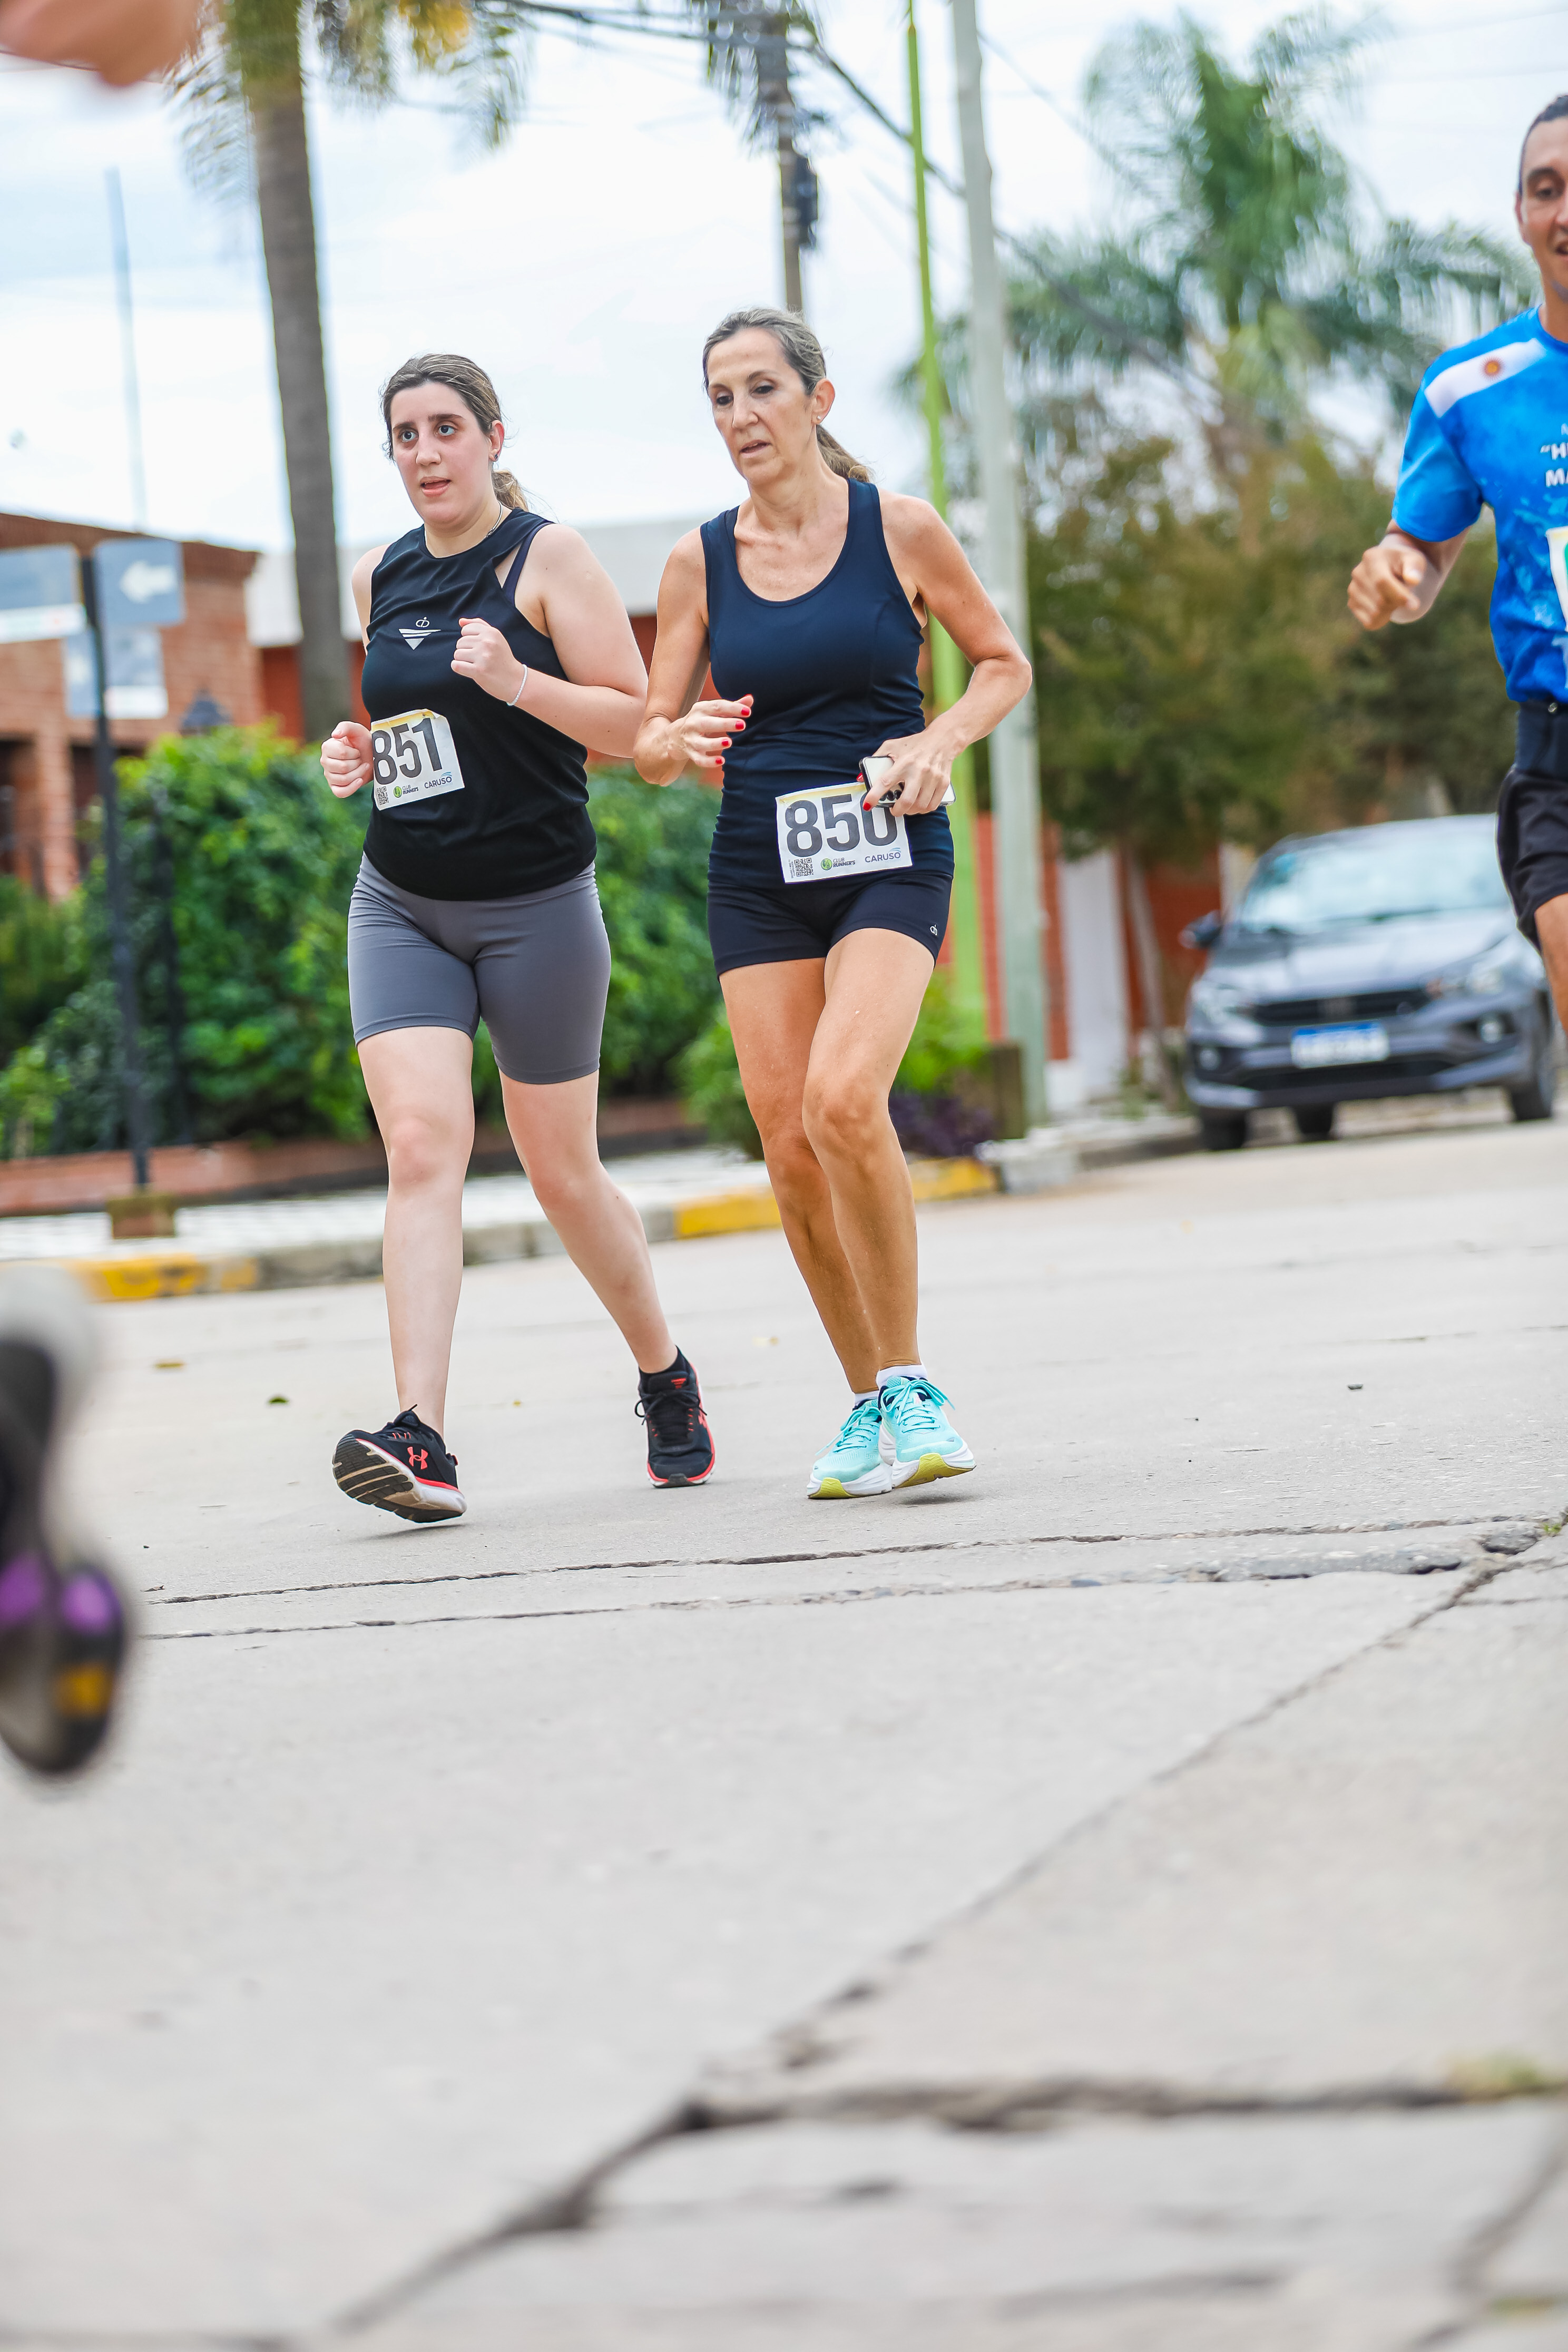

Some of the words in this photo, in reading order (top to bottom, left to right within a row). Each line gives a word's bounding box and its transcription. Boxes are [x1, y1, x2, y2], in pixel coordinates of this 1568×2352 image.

[1545, 468, 1568, 487] M
[371, 718, 443, 785] 851
[424, 777, 452, 789] CARUSO
[785, 792, 898, 857] 850
[865, 852, 901, 863] CARUSO
